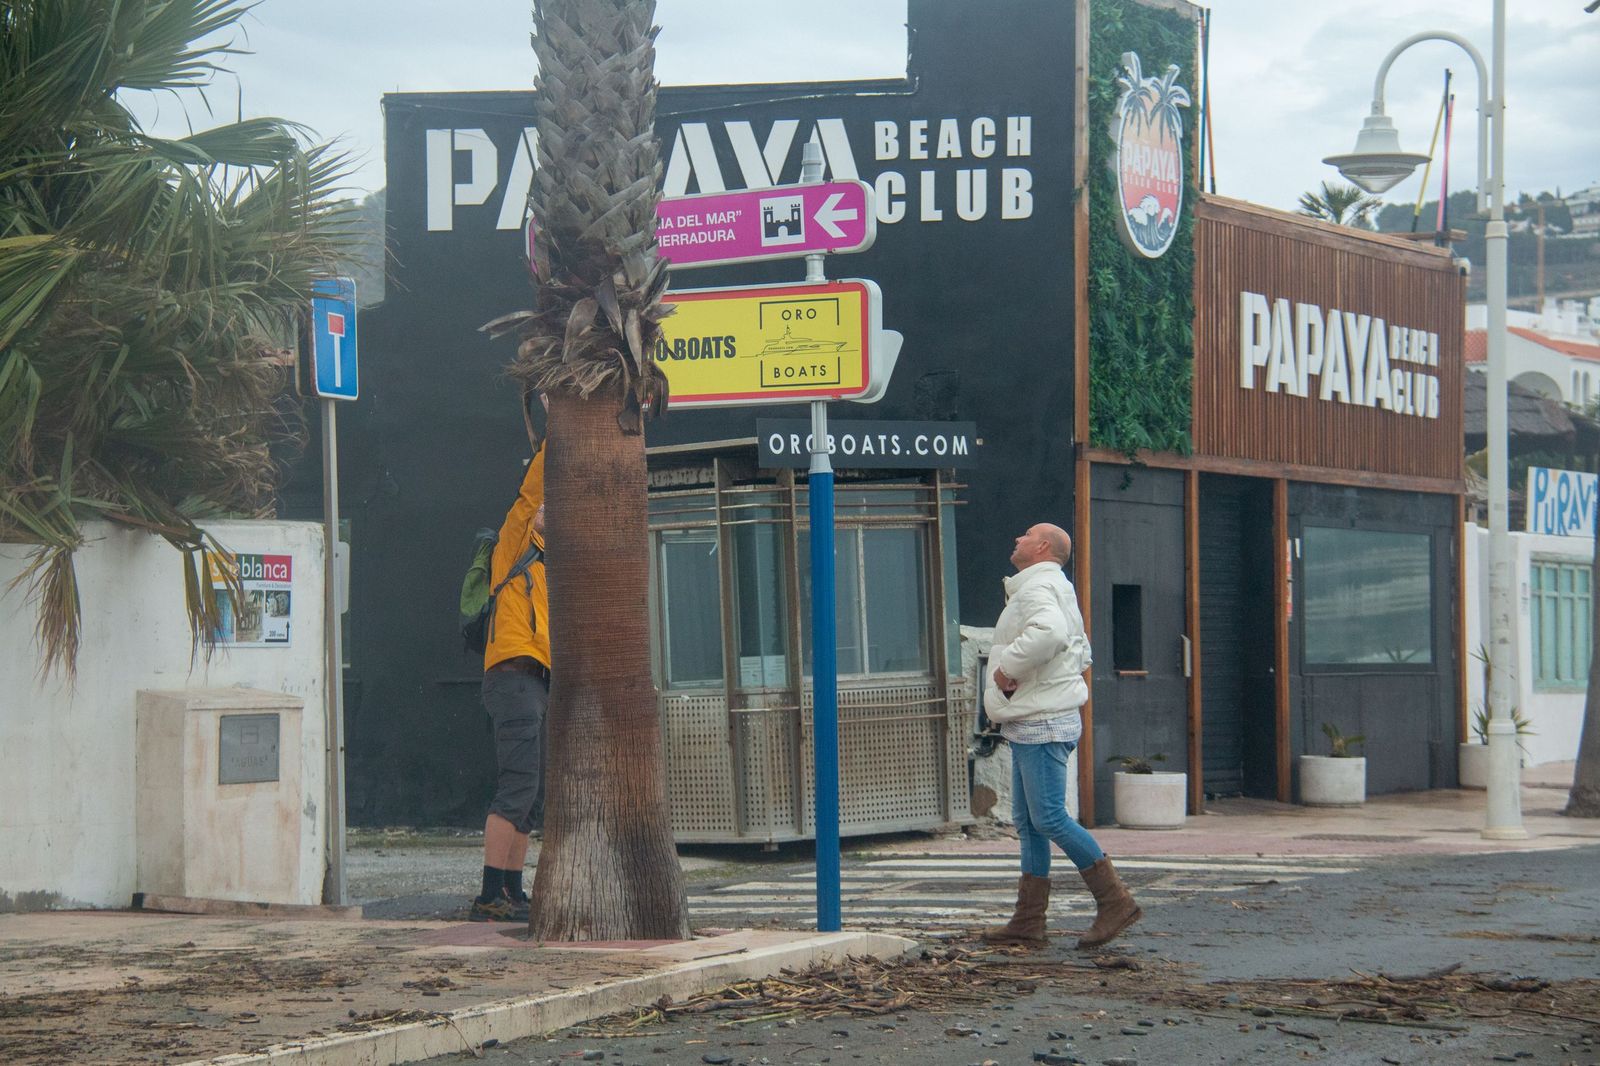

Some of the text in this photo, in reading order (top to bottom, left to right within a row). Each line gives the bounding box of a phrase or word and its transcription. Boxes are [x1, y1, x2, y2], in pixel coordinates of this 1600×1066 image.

[874, 116, 1032, 160] BEACH
[426, 118, 859, 231] PAAYA
[1122, 142, 1176, 182] PAPAYA
[875, 168, 1034, 224] CLUB
[658, 217, 673, 230] IA
[677, 214, 703, 228] DEL
[781, 308, 817, 321] ORO
[673, 335, 736, 361] BOATS
[1240, 291, 1393, 411] PAPAYA
[1390, 325, 1439, 367] BEACH
[773, 364, 827, 378] BOATS
[1391, 368, 1439, 419] CLUB
